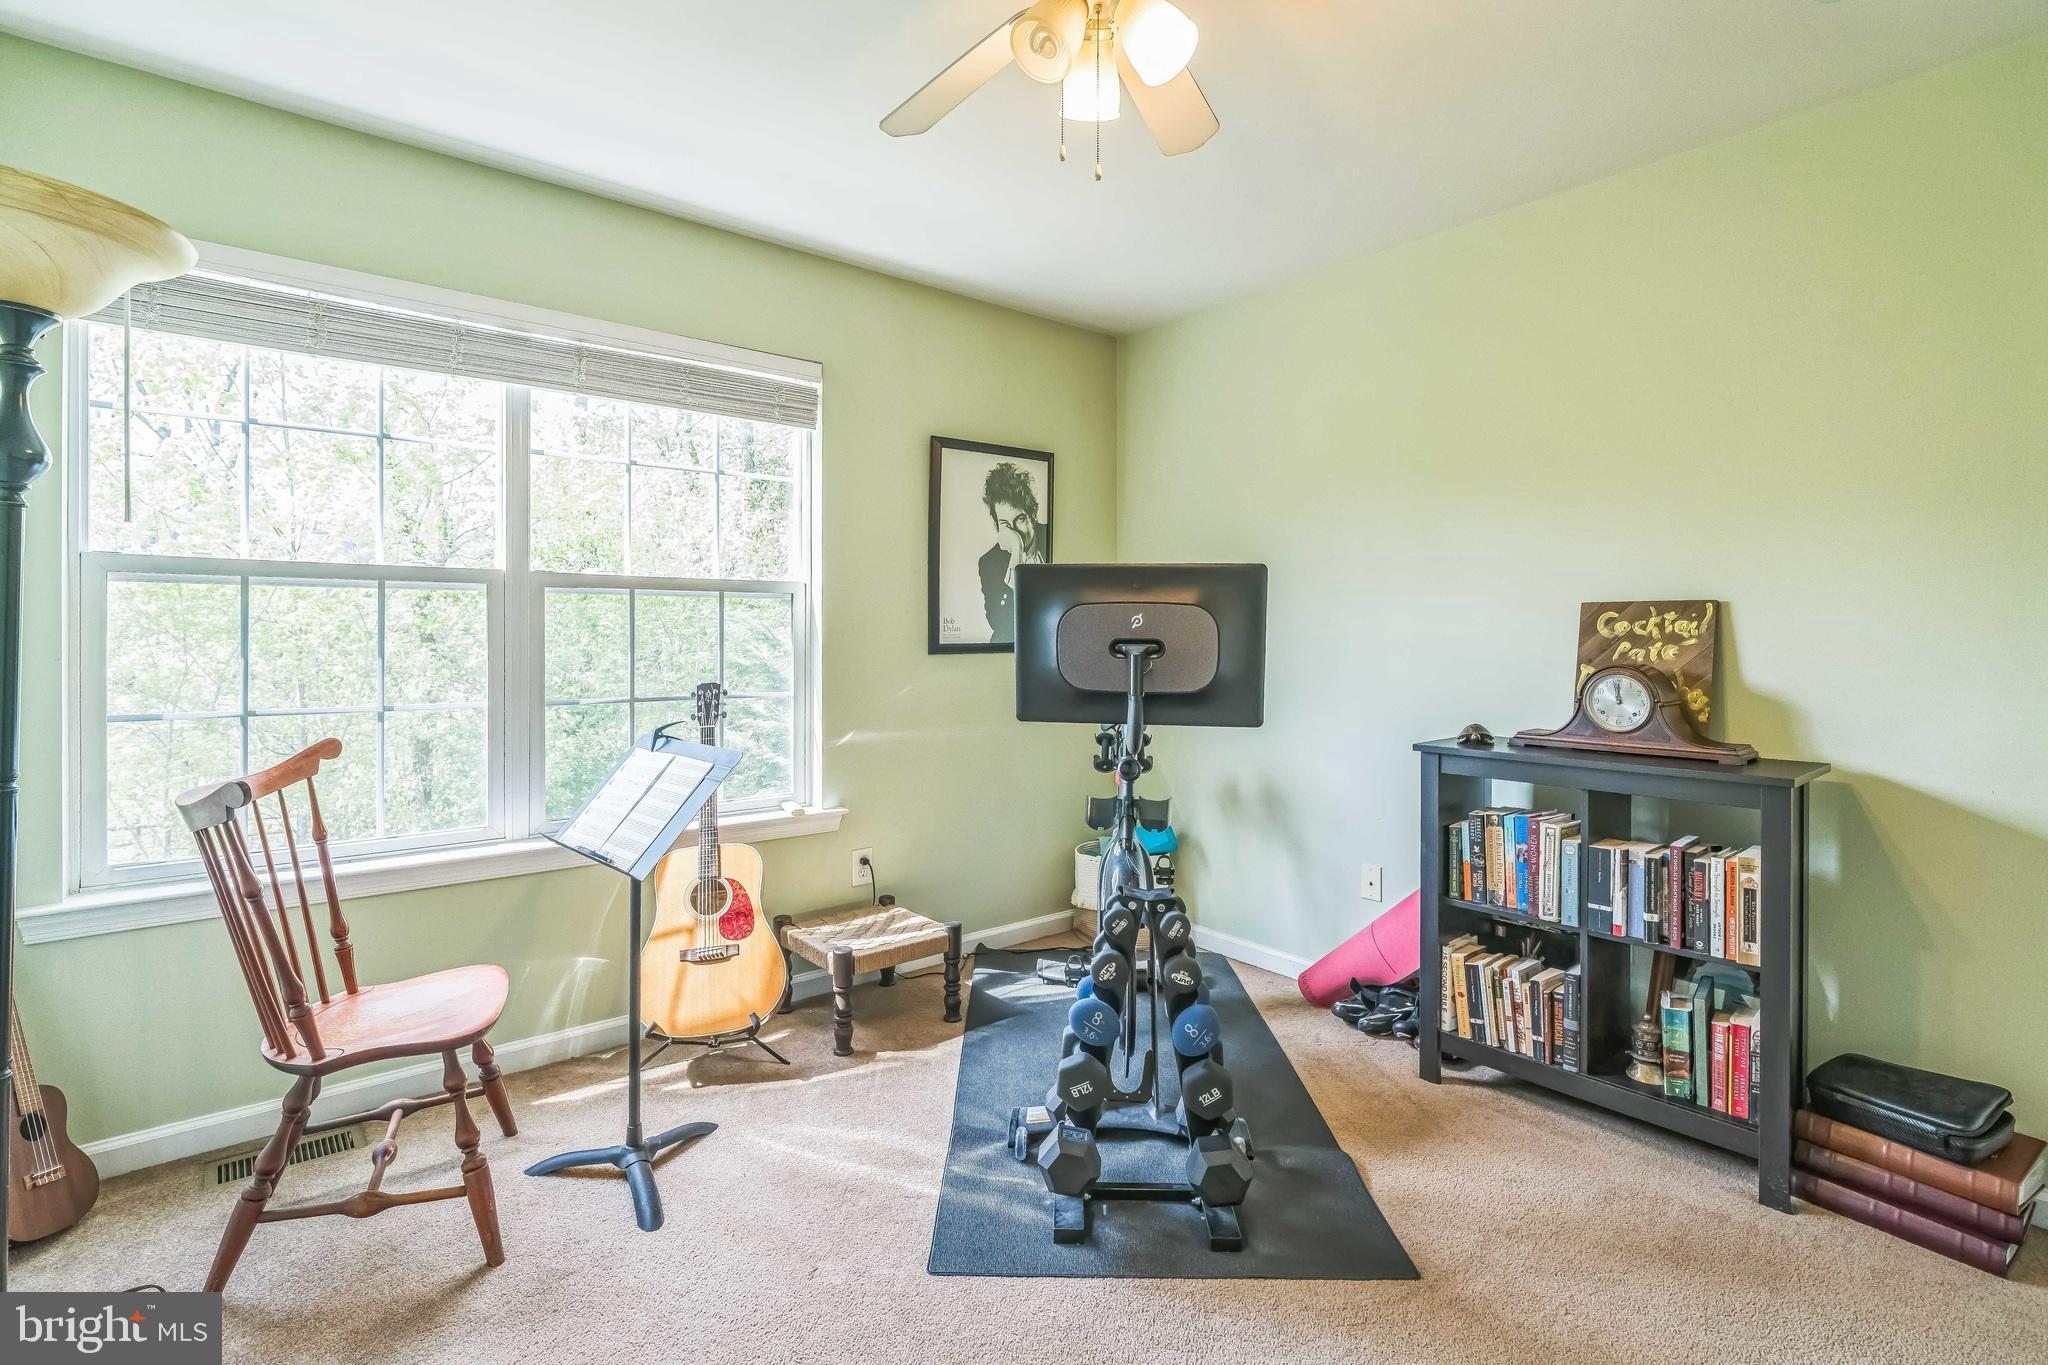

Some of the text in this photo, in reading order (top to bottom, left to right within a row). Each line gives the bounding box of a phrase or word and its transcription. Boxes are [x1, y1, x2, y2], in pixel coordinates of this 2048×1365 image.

[1597, 603, 1713, 638] Cocktail
[944, 625, 960, 633] Dylan
[1694, 871, 1704, 896] MALCOLM
[1092, 1012, 1103, 1025] 8
[1082, 1027, 1096, 1039] 3.6
[1184, 1023, 1199, 1038] 8
[1555, 1019, 1563, 1046] SARCASM
[1199, 1035, 1212, 1048] 3.6
[1071, 1083, 1093, 1097] 12LB
[1198, 1087, 1221, 1105] 12LB
